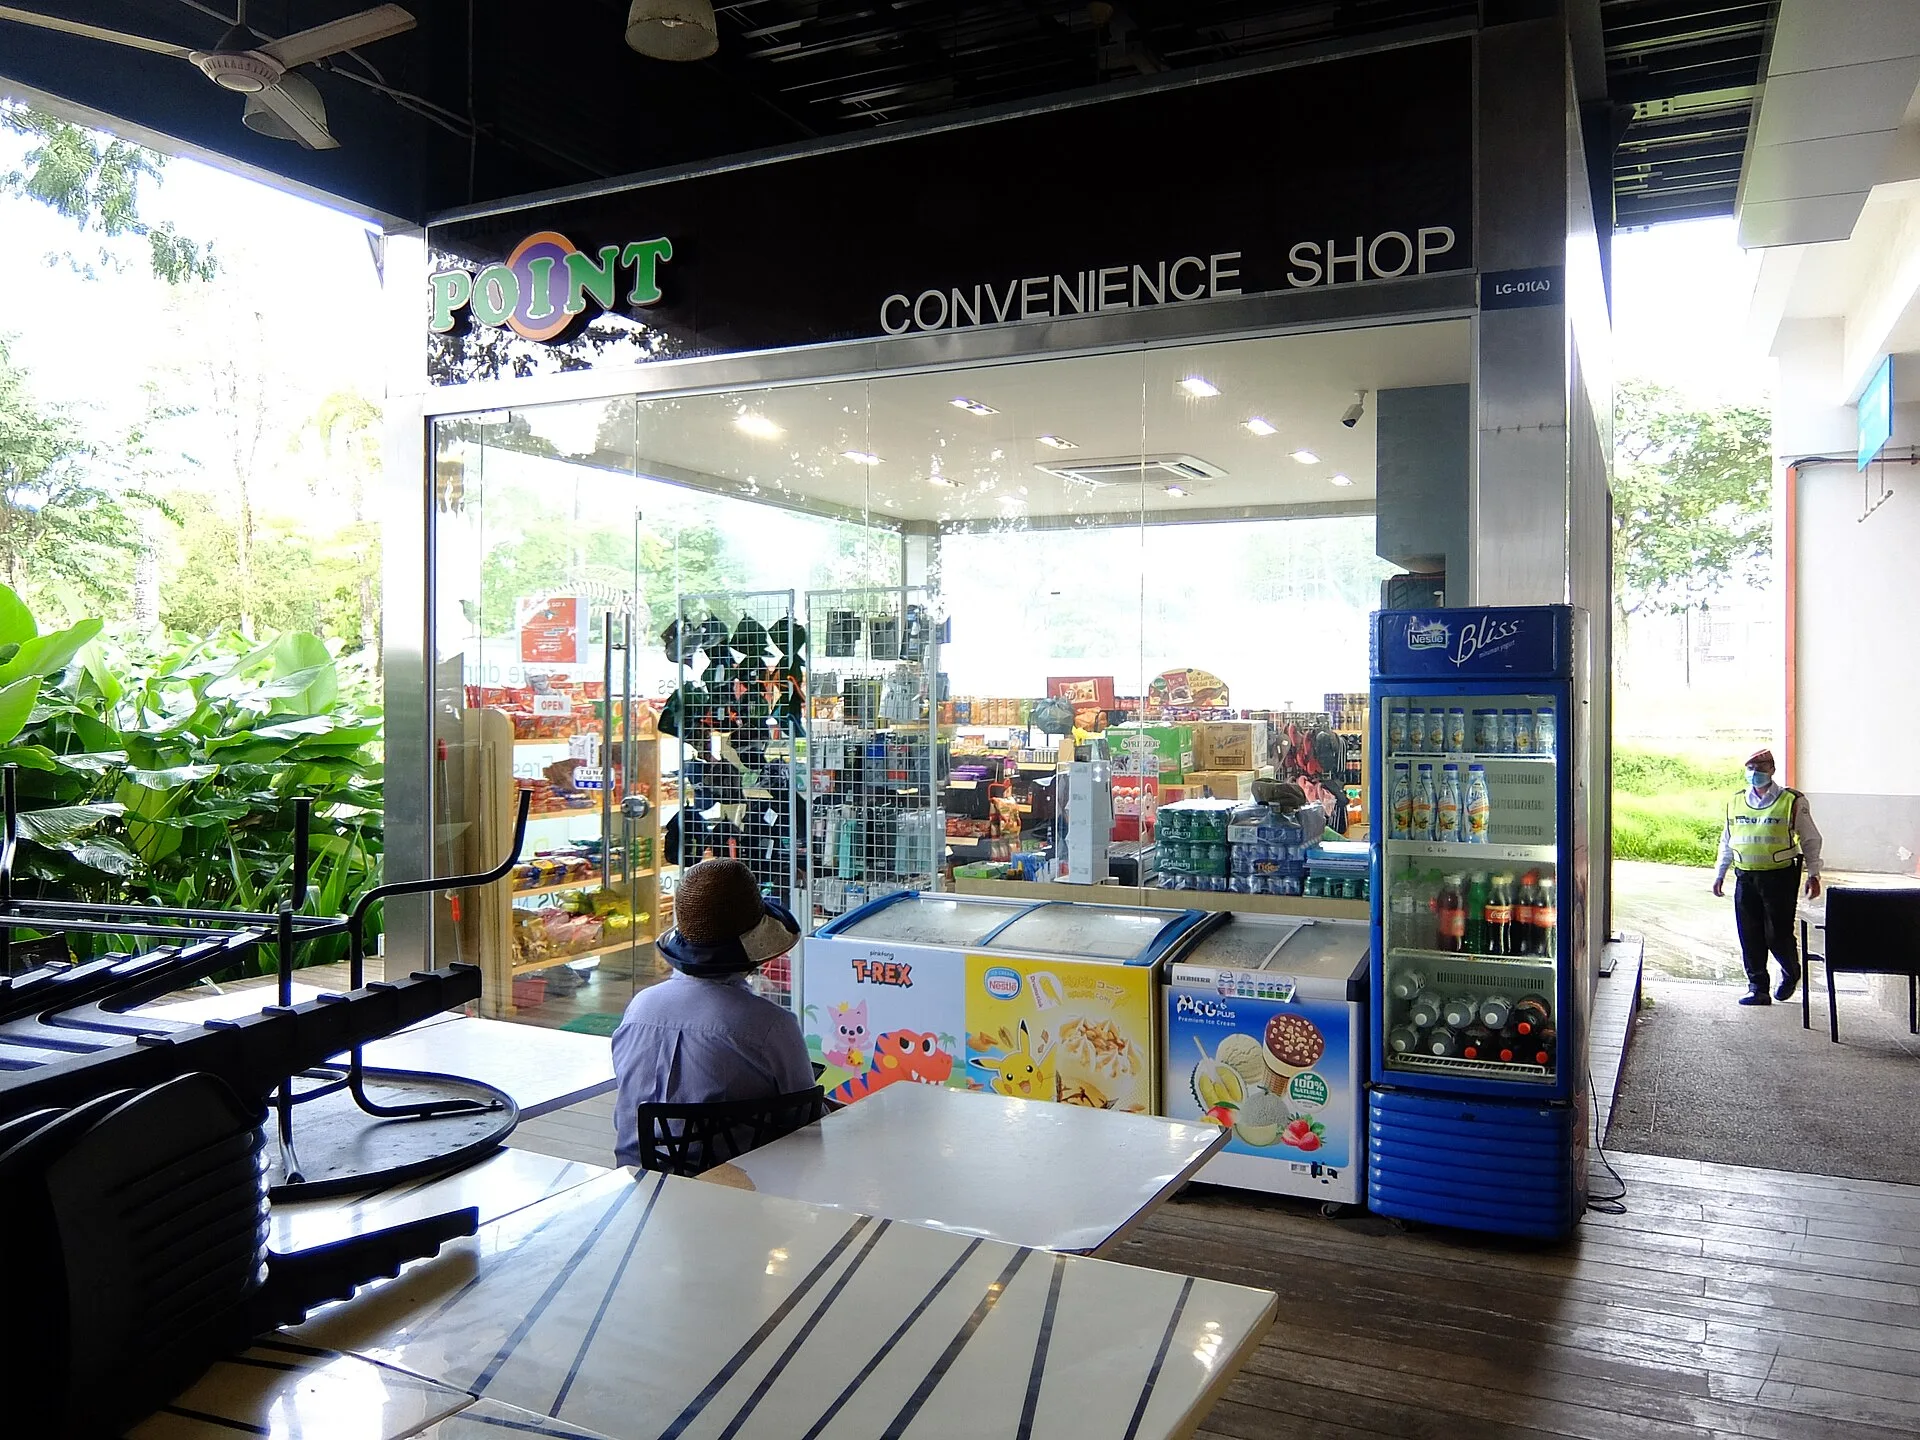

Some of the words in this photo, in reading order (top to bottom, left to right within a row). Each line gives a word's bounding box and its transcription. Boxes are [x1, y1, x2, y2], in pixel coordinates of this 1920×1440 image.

[429, 237, 673, 333] POINT
[881, 252, 1242, 334] CONVENIENCE
[1287, 226, 1455, 287] SHOP
[1495, 280, 1551, 295] LG-01(A)
[1448, 615, 1520, 668] Bliss
[541, 700, 564, 710] OPEN
[1161, 827, 1191, 839] Carlsberg
[1160, 859, 1191, 871] Carlsberg
[852, 959, 913, 988] T-REX
[1216, 1010, 1236, 1018] PLUS
[1178, 1016, 1205, 1024] Premium
[1216, 1019, 1236, 1027] Cream
[1294, 1078, 1325, 1092] 100%
[1294, 1087, 1324, 1097] NATURAL
